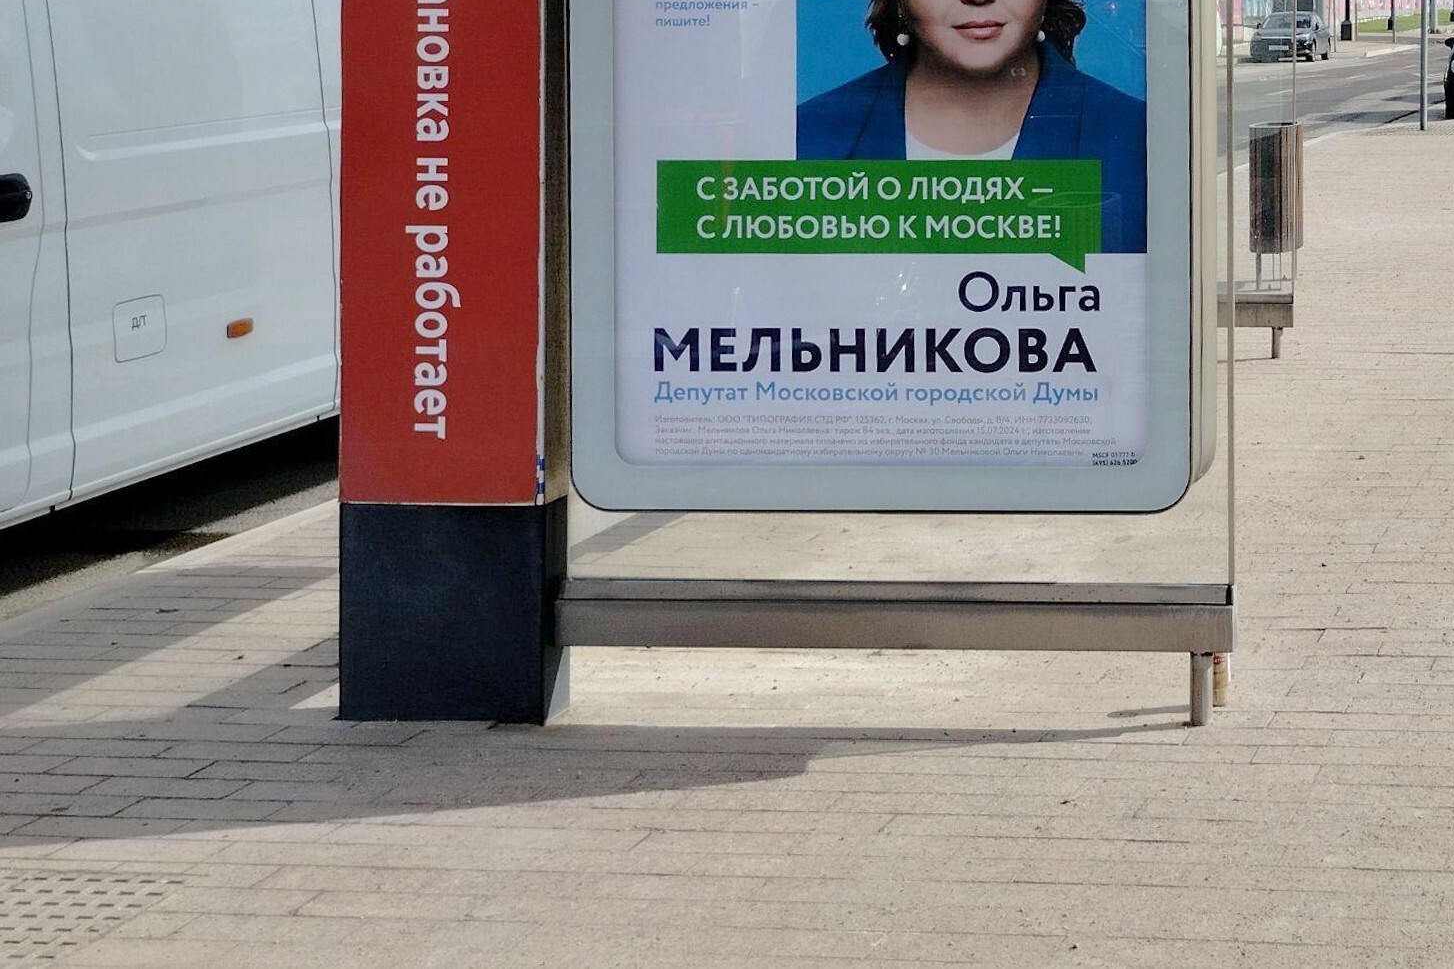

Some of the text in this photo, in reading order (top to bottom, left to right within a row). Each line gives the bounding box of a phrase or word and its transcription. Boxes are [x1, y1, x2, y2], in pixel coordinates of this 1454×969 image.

[655, 1, 747, 13] предложения
[655, 15, 711, 28] пишите!
[415, 157, 449, 211] не
[696, 176, 716, 201] С
[722, 171, 869, 201] ЗАБОТОЙ
[876, 176, 902, 201] О
[908, 176, 1025, 204] ЛЮДЯХ
[696, 214, 1061, 239] С ЛЮБОВЬЮ К МОСКВЕ!
[958, 270, 1100, 313] Ольга
[404, 225, 462, 441] работает
[653, 327, 1098, 374] МЕЛЬНИКОВА
[653, 380, 1098, 406] Депутат Московской городской Думы
[717, 415, 741, 424] ООО
